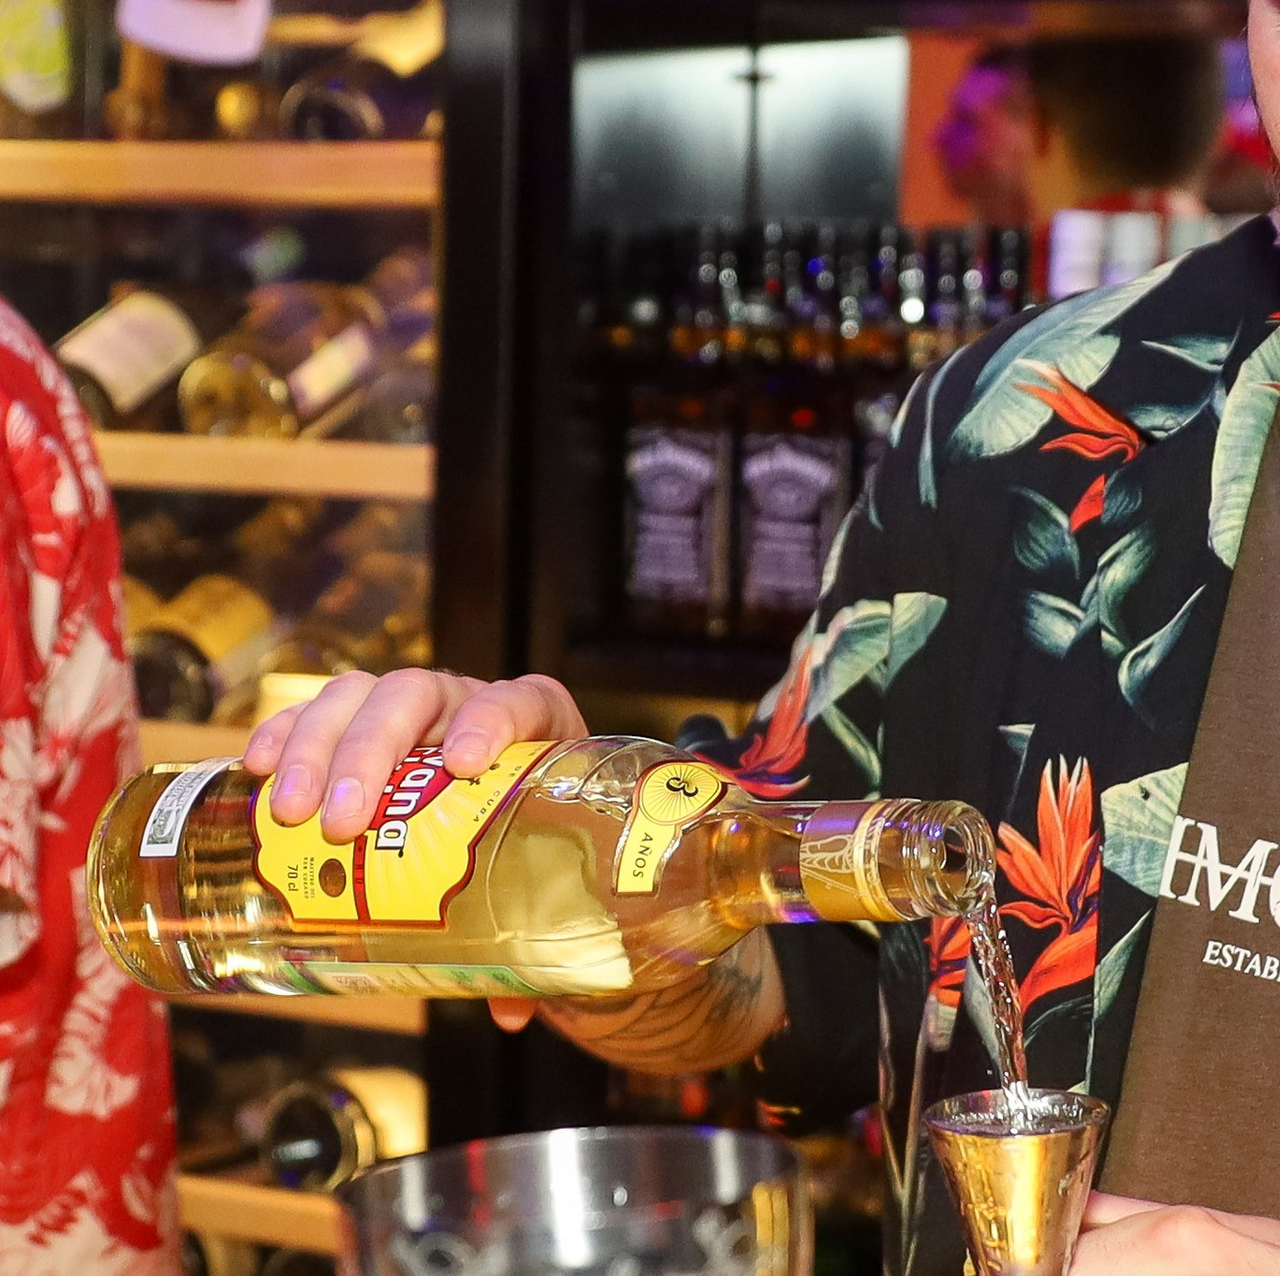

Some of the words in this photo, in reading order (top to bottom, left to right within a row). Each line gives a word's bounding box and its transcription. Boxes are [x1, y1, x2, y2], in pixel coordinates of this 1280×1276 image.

[666, 777, 699, 797] 3
[375, 754, 444, 858] vana
[632, 832, 654, 879] AÑOS
[287, 864, 299, 880] 70
[287, 882, 299, 892] cl
